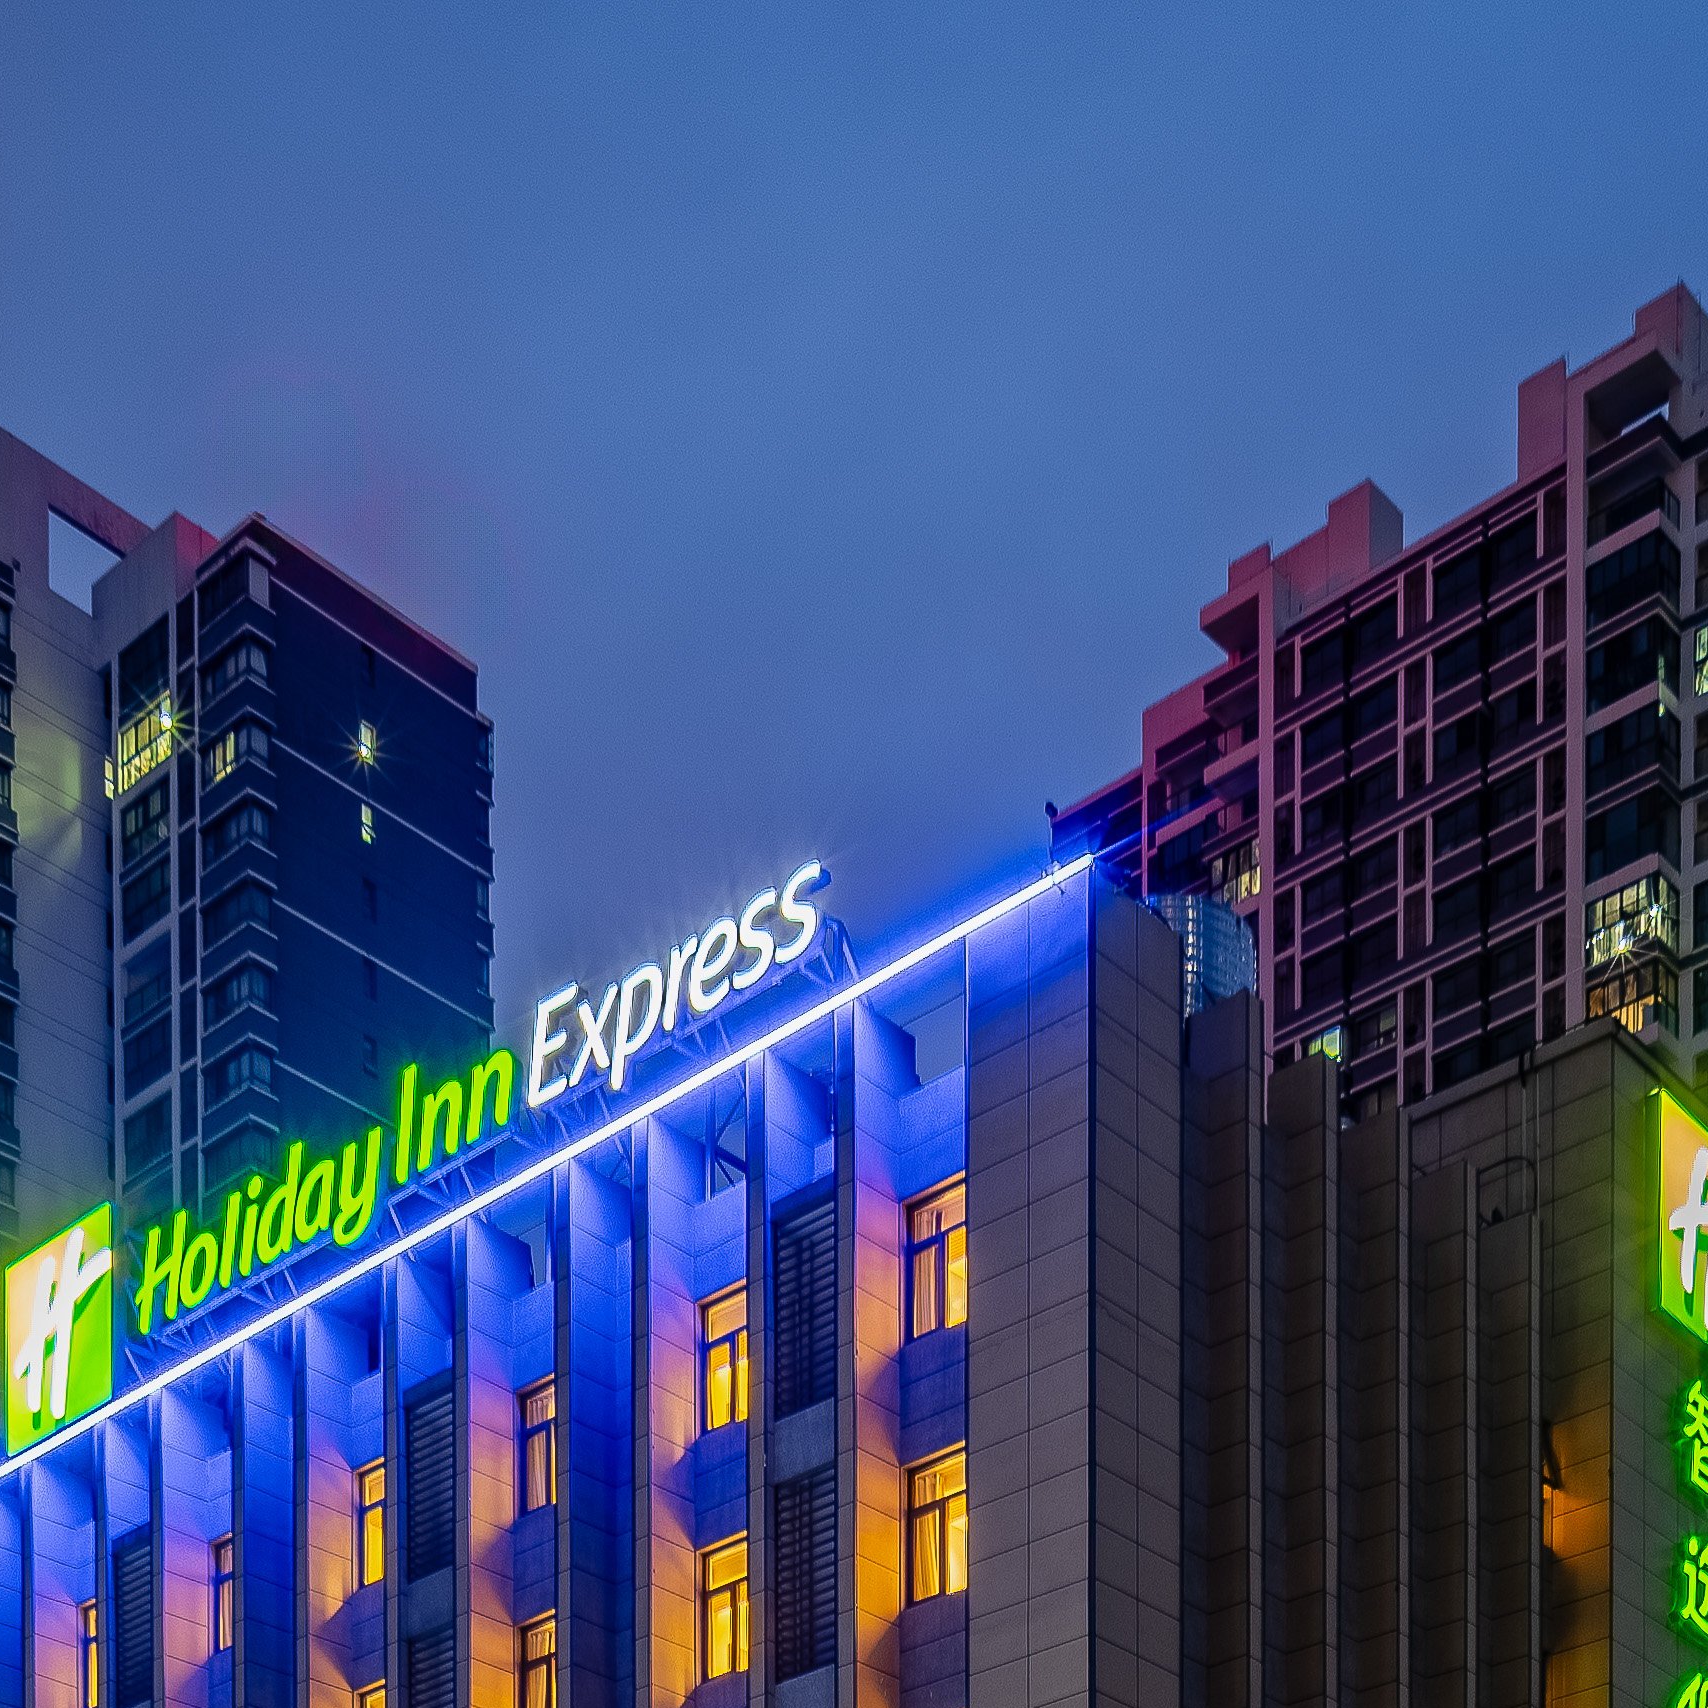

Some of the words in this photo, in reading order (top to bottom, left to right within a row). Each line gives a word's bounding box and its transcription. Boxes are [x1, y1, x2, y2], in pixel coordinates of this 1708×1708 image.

[133, 1124, 384, 1336] Holiday
[394, 1048, 514, 1185] Inn
[526, 860, 823, 1109] Express
